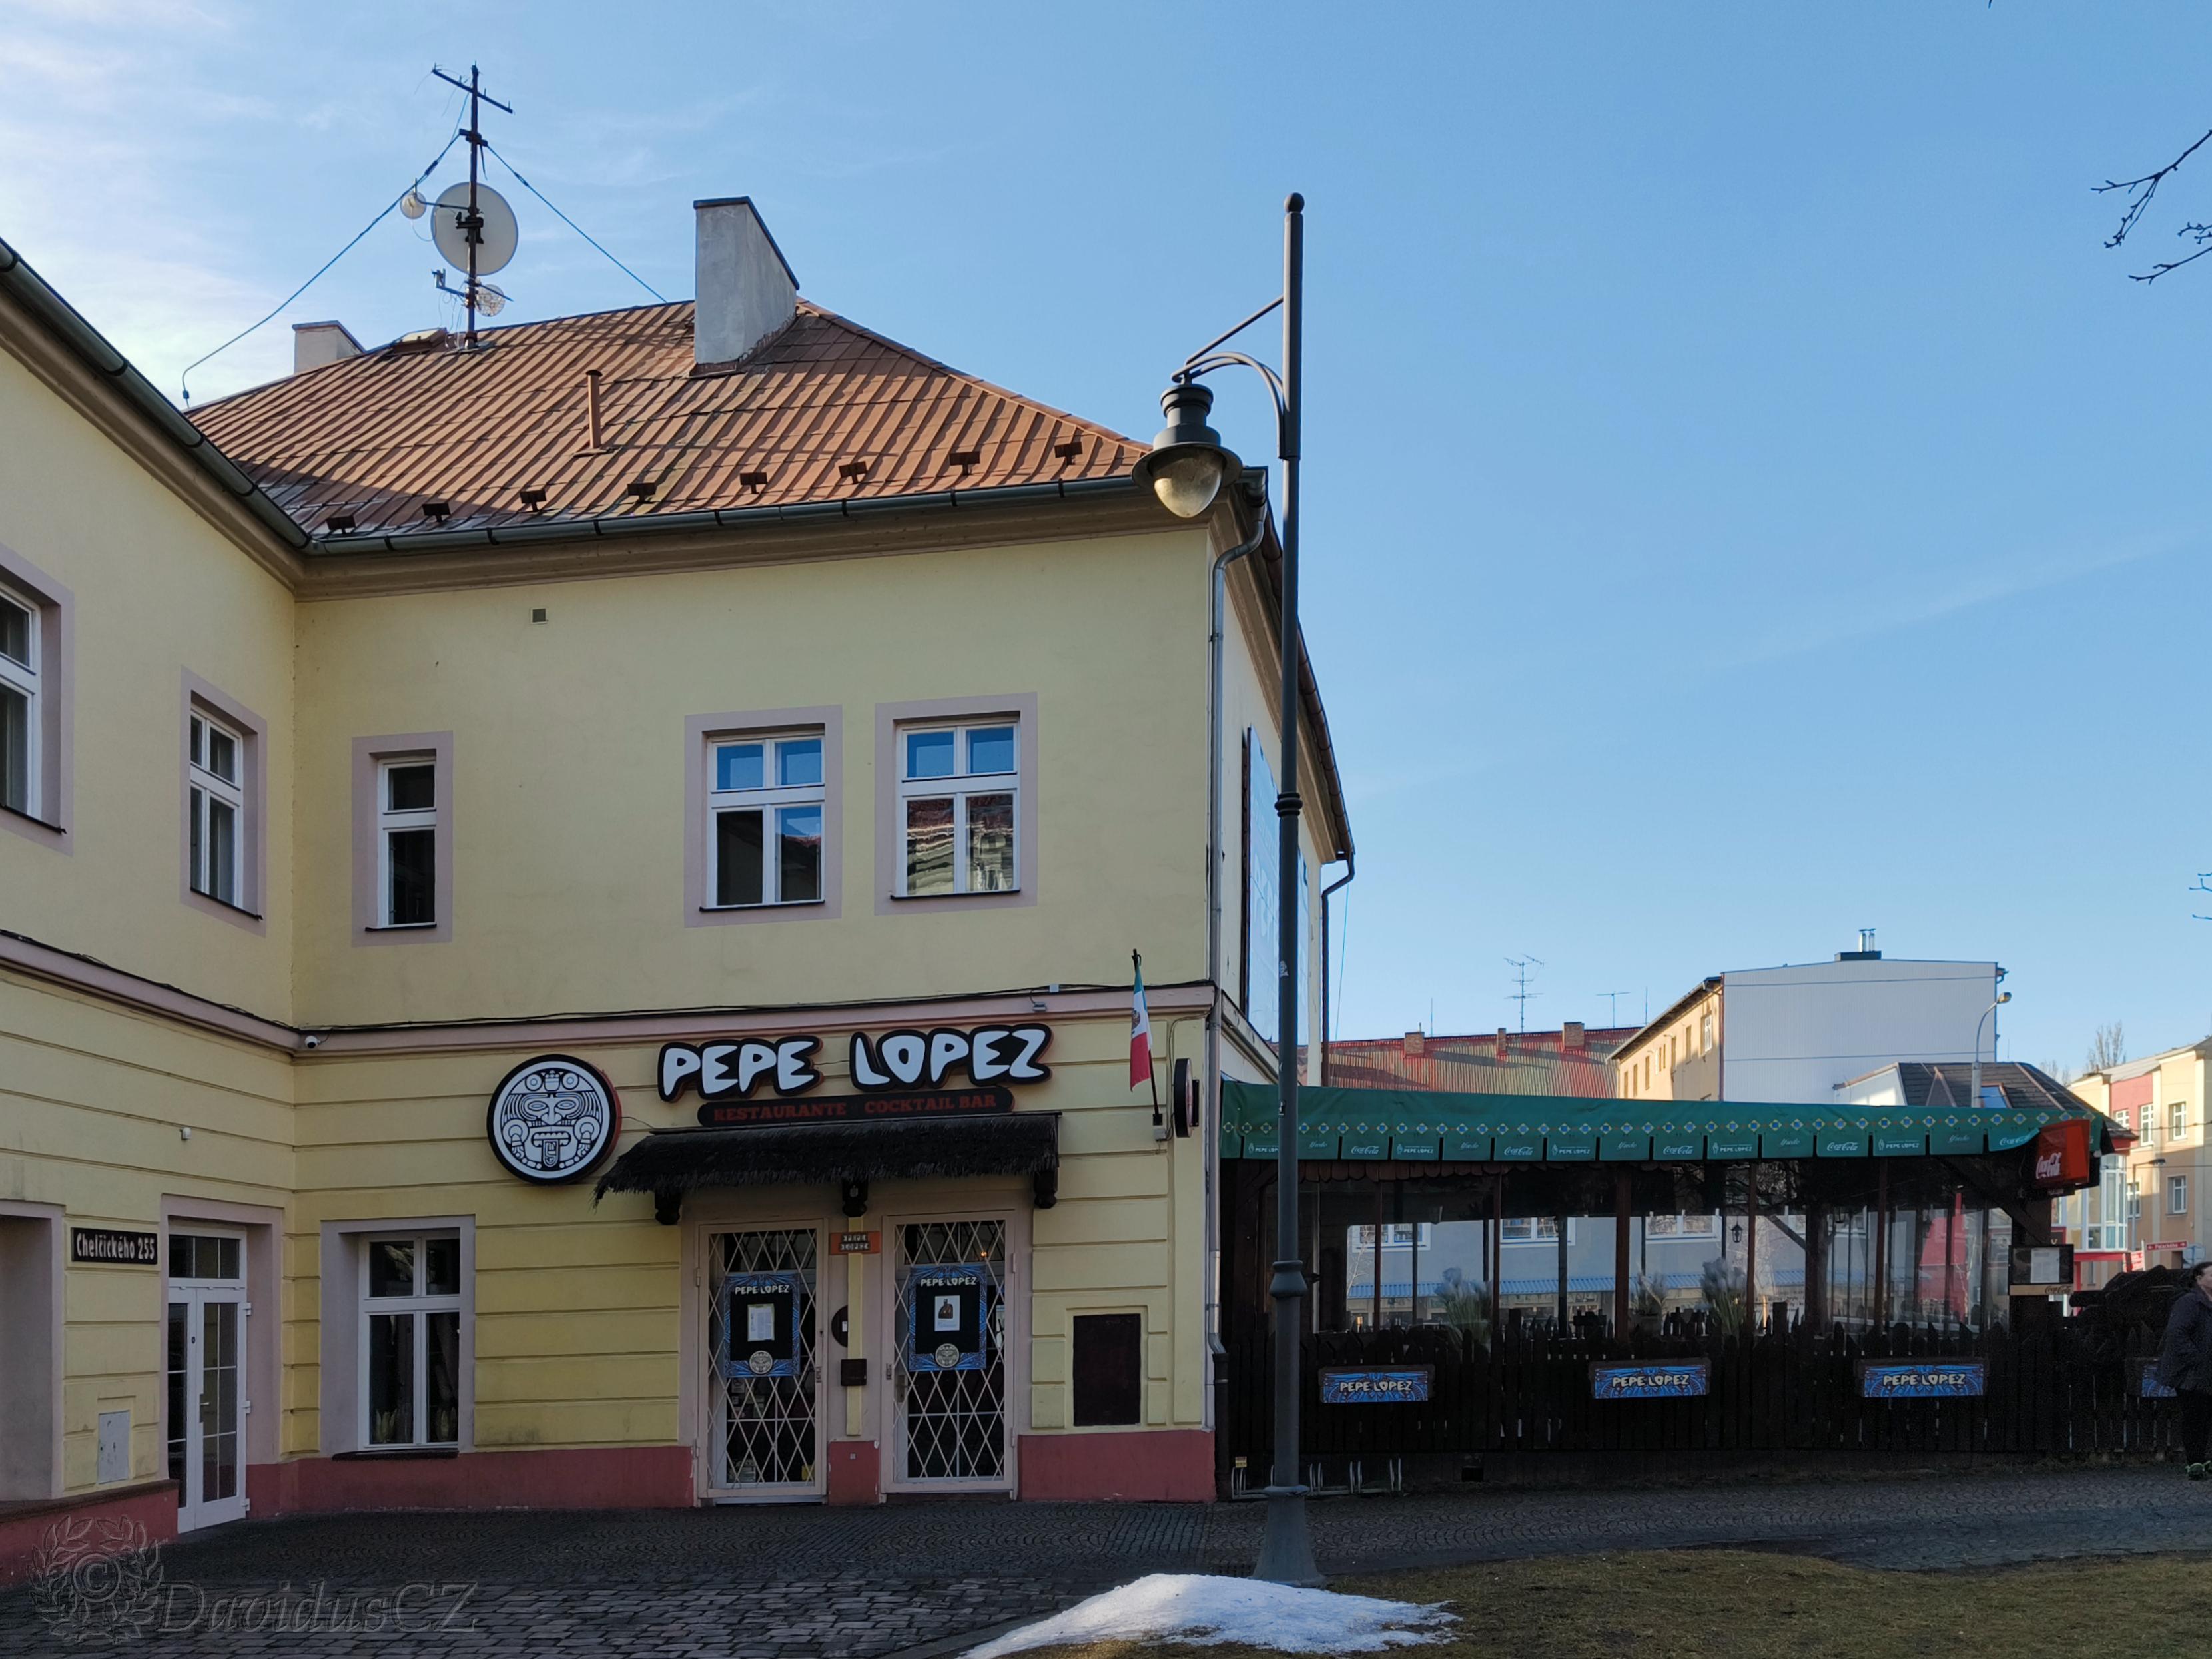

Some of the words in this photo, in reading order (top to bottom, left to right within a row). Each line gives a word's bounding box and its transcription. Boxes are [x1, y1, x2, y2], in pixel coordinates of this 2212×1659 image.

[659, 1037, 819, 1100] PEPE
[851, 1026, 1050, 1088] LOPEZ
[713, 1102, 847, 1122] RESTAURANTE
[865, 1098, 955, 1115] COCKTAIL
[958, 1094, 996, 1111] BAR
[77, 1233, 135, 1259] Chelčického
[137, 1237, 155, 1260] 255
[920, 1277, 944, 1287] PEPE
[946, 1277, 977, 1286] LOPEZ
[735, 1285, 758, 1295] PEPE
[760, 1285, 790, 1294] LOPEZ
[1612, 1376, 1645, 1387] PEPE
[1648, 1374, 1690, 1386] LOPEZ
[1883, 1374, 1918, 1386] PEPE
[1921, 1373, 1966, 1385] LOPEZ
[1340, 1381, 1370, 1392] PEPE
[1373, 1381, 1413, 1391] LOPEZ
